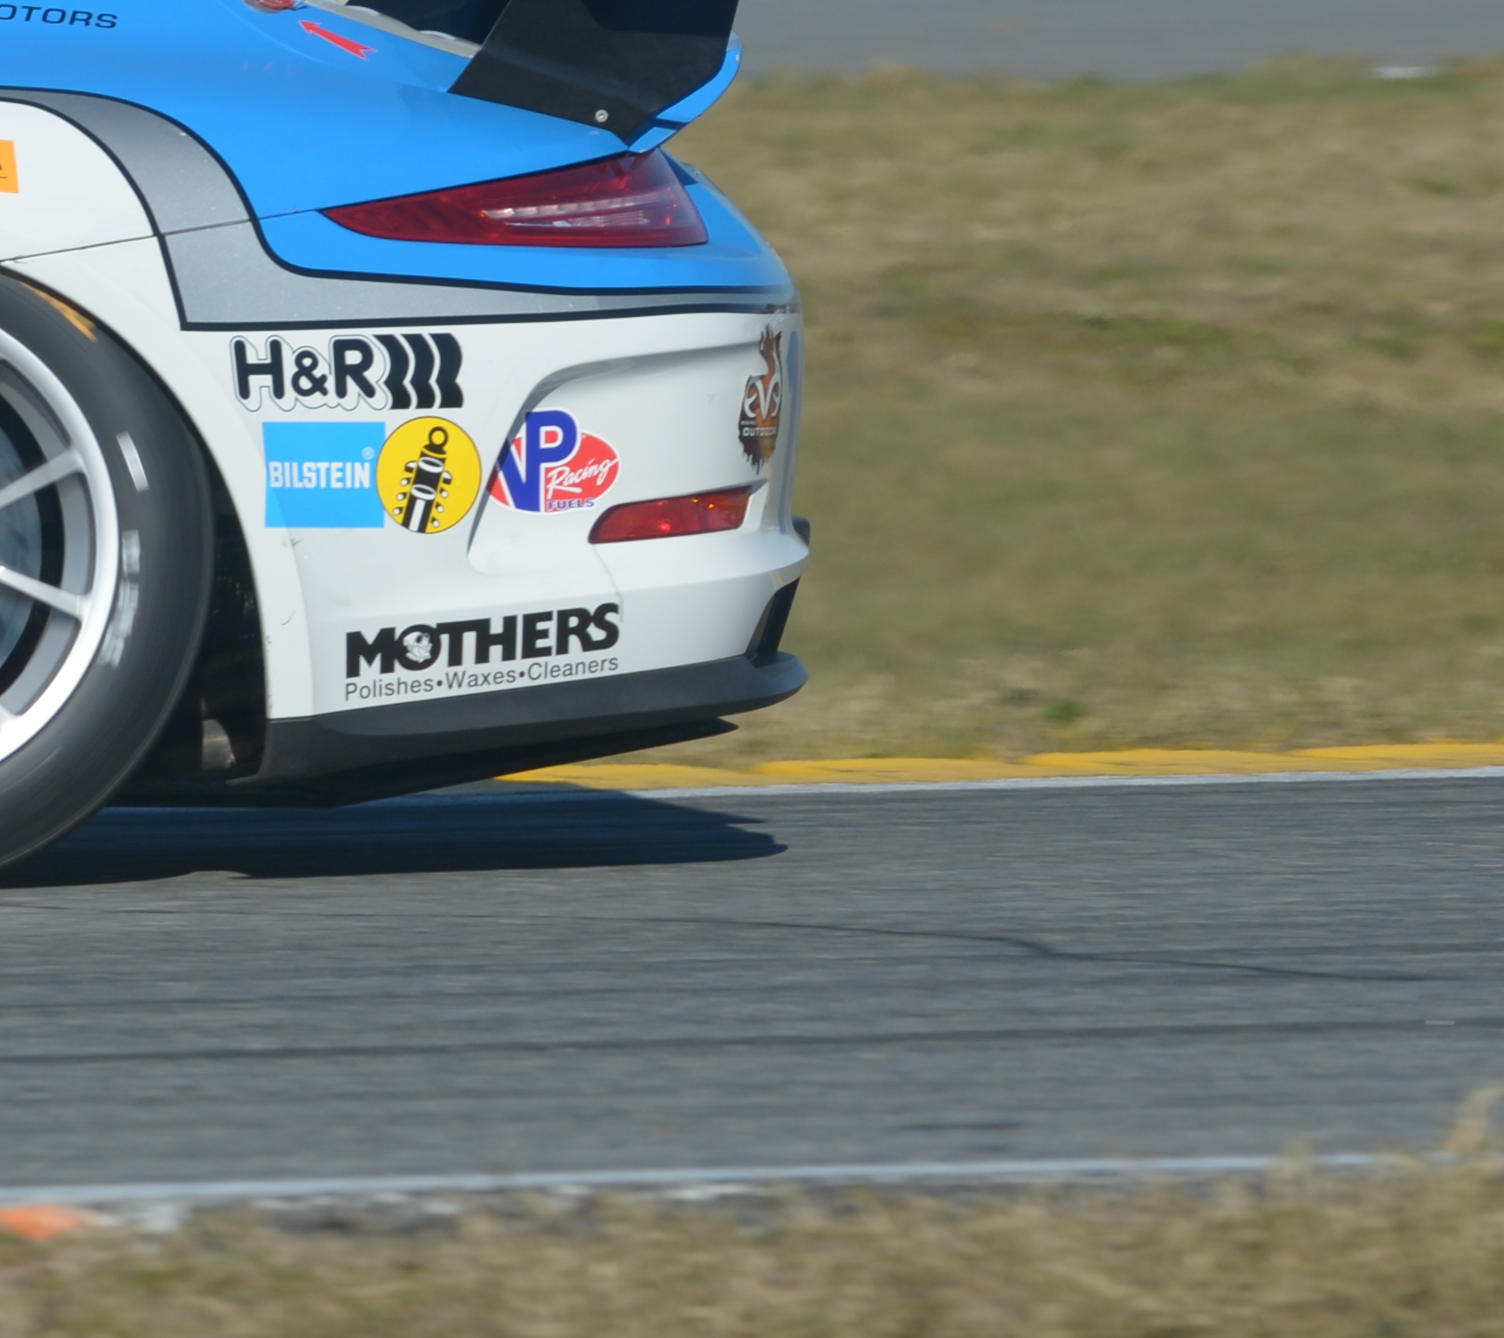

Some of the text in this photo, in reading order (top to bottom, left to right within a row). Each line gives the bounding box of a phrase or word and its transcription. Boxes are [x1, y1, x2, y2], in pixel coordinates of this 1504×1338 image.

[232, 336, 382, 407] H&R
[269, 461, 370, 489] BILSTEIN
[496, 410, 577, 512] VP
[547, 458, 619, 499] Racing
[548, 498, 594, 510] FUELS
[345, 602, 619, 678] MOTHERS
[345, 656, 619, 702] Polishes Waxes Cleaners
